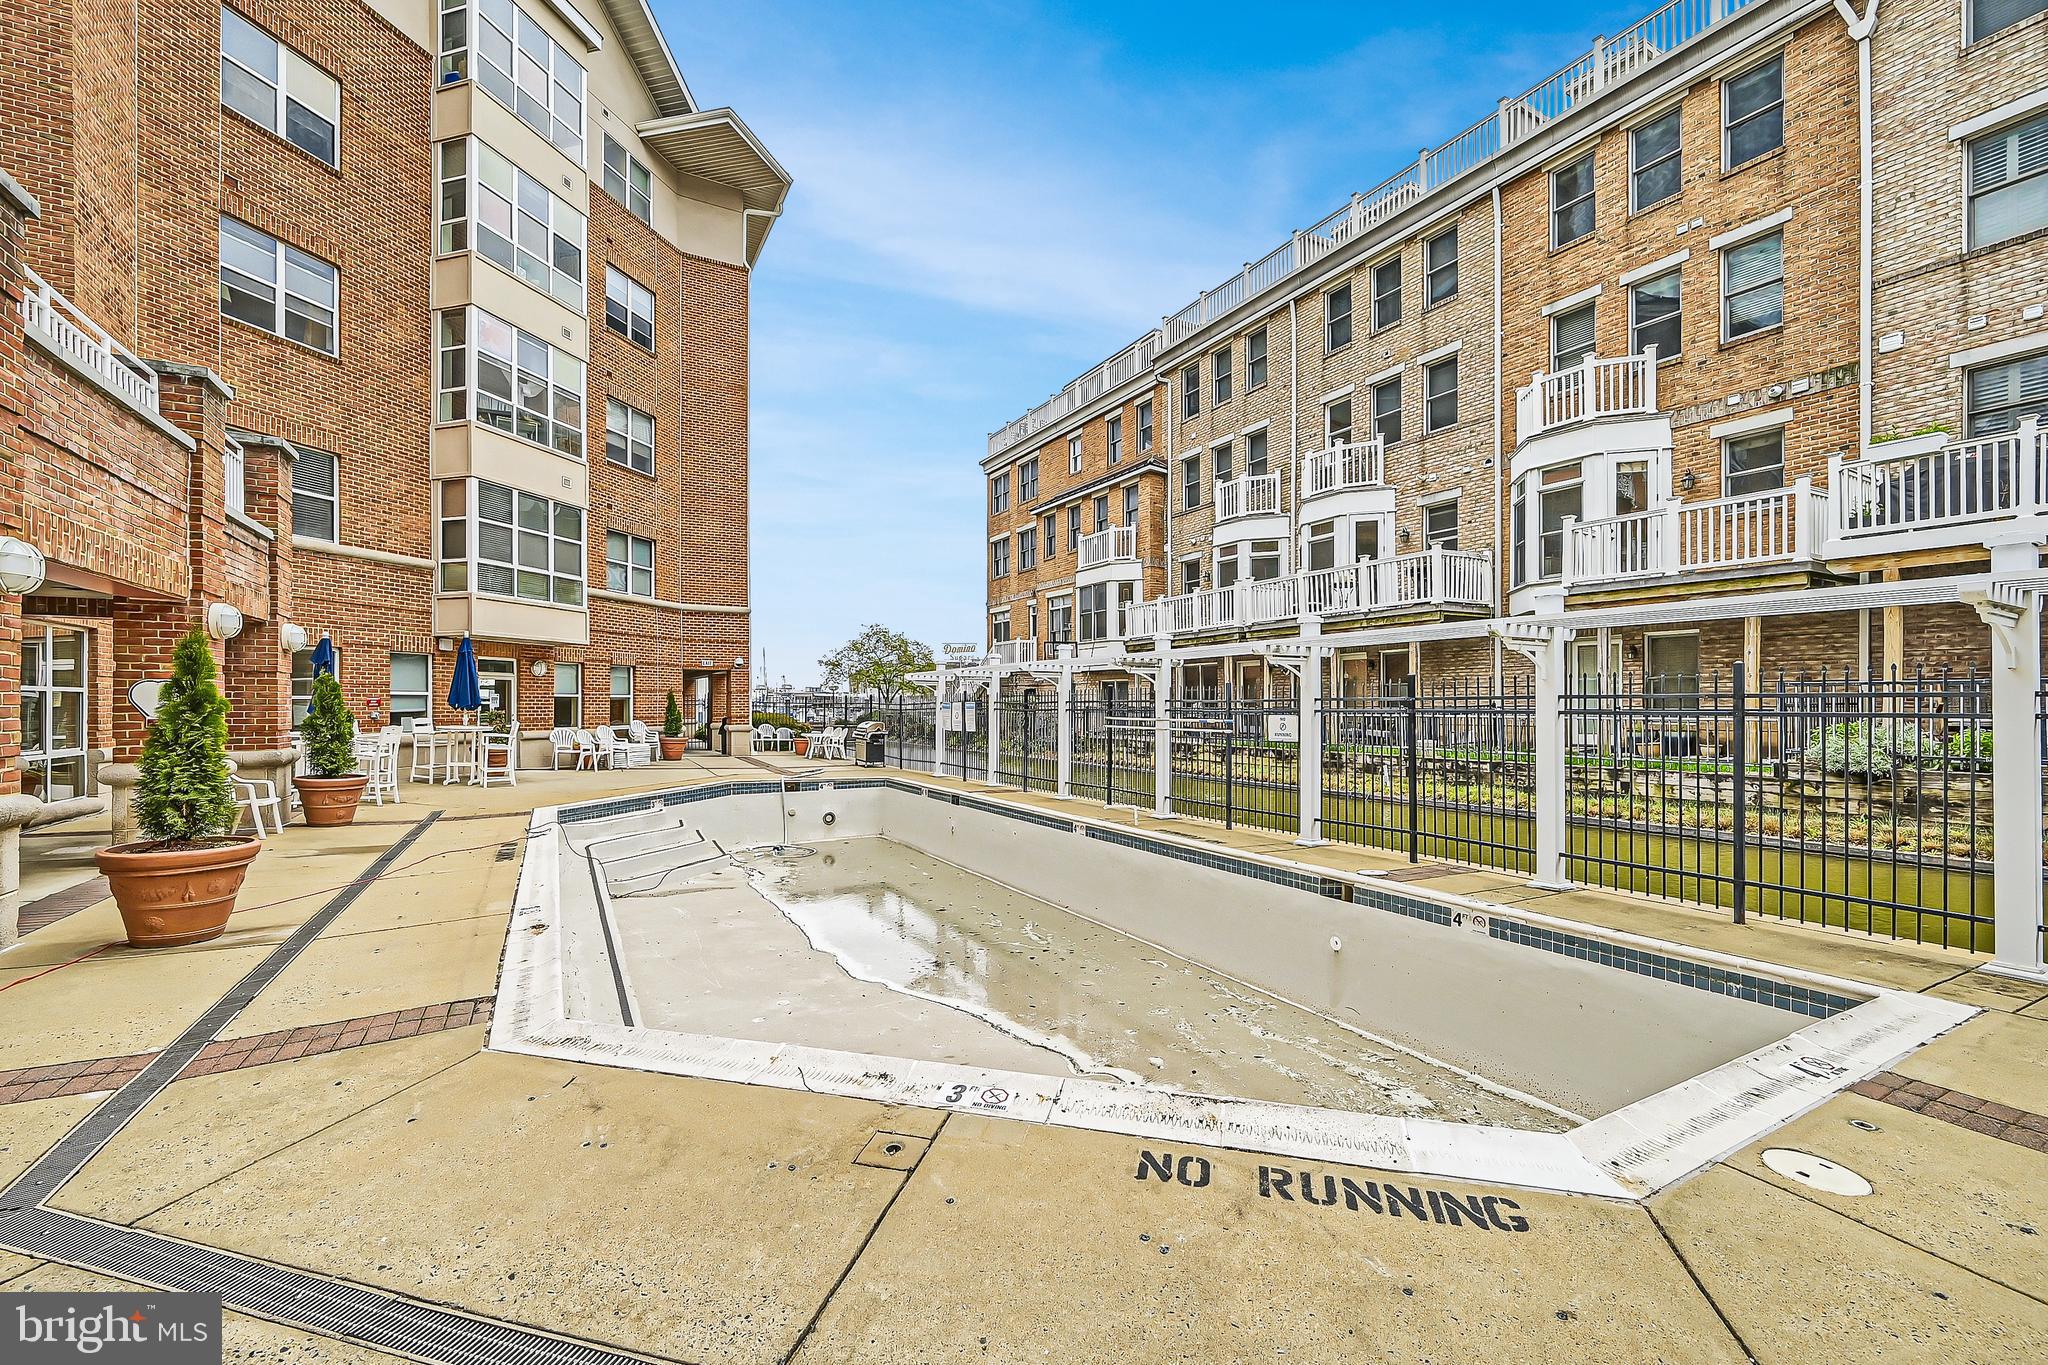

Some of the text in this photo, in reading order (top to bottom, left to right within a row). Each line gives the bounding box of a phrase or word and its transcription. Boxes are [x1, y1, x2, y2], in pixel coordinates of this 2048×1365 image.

[943, 643, 976, 655] Domino
[1453, 912, 1463, 927] 4
[945, 1084, 967, 1103] 3
[1134, 1150, 1530, 1233] NO RUNNING
